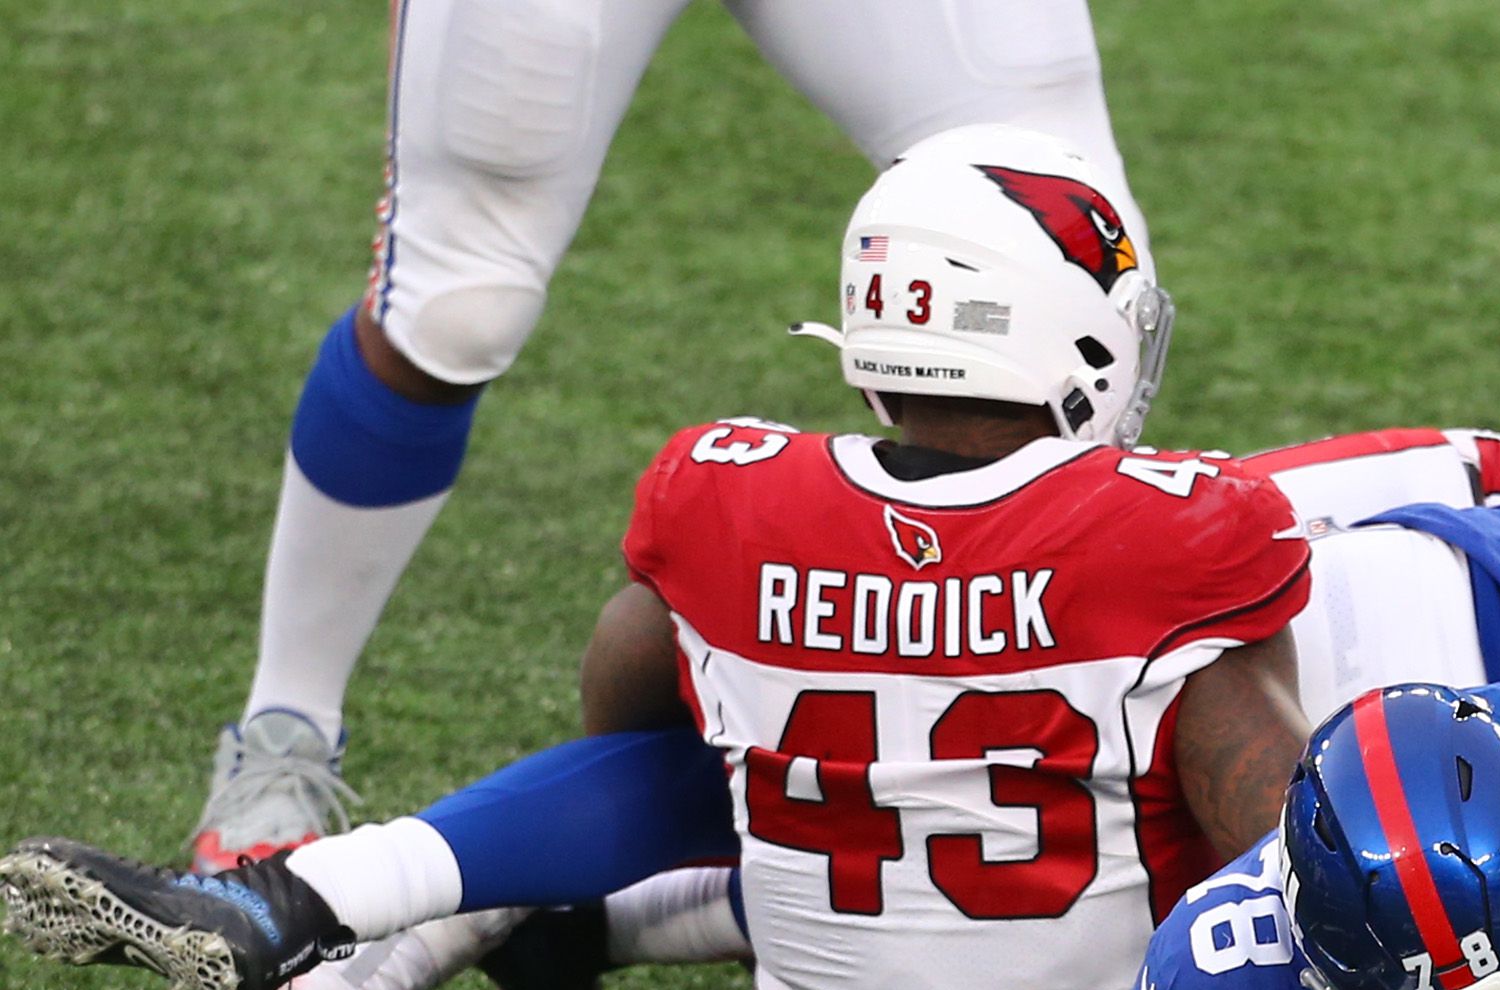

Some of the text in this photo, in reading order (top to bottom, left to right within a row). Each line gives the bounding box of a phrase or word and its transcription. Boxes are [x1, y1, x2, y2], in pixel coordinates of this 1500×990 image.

[881, 364, 912, 377] LIVES
[915, 367, 967, 380] MATTER
[757, 561, 1056, 658] REDDICK
[744, 688, 1099, 921] 43
[1186, 838, 1294, 976] 78
